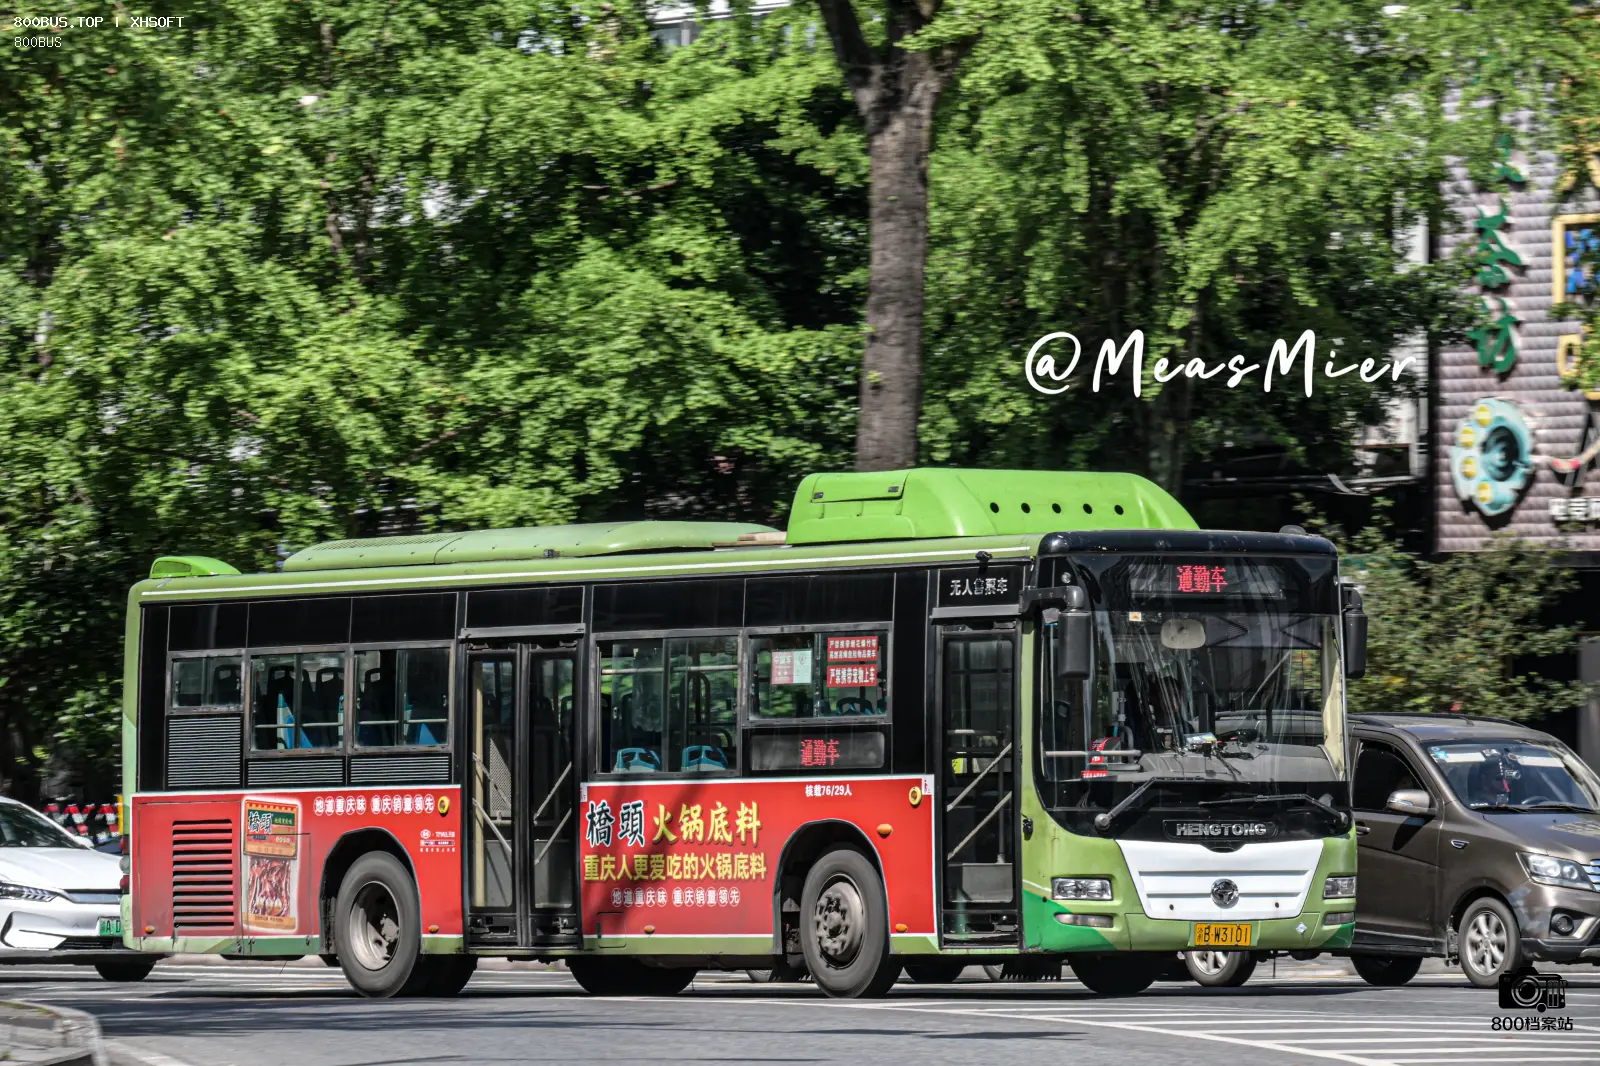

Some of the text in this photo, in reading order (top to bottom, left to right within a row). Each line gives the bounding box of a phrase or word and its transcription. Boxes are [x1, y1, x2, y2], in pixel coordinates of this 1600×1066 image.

[949, 577, 1009, 596] 无人售票车
[1177, 565, 1228, 593] 通勤车
[800, 739, 840, 766] 通勤车
[805, 784, 852, 797] 核载76/29人
[314, 794, 435, 816] 地道重庆味 重庆销量领先
[652, 800, 762, 847] 火锅底料
[1176, 823, 1267, 836] HENGTONG
[583, 852, 767, 882] 重庆人更爱吃的火锅底料
[612, 887, 740, 907] 地道重庆味 重庆销量领先
